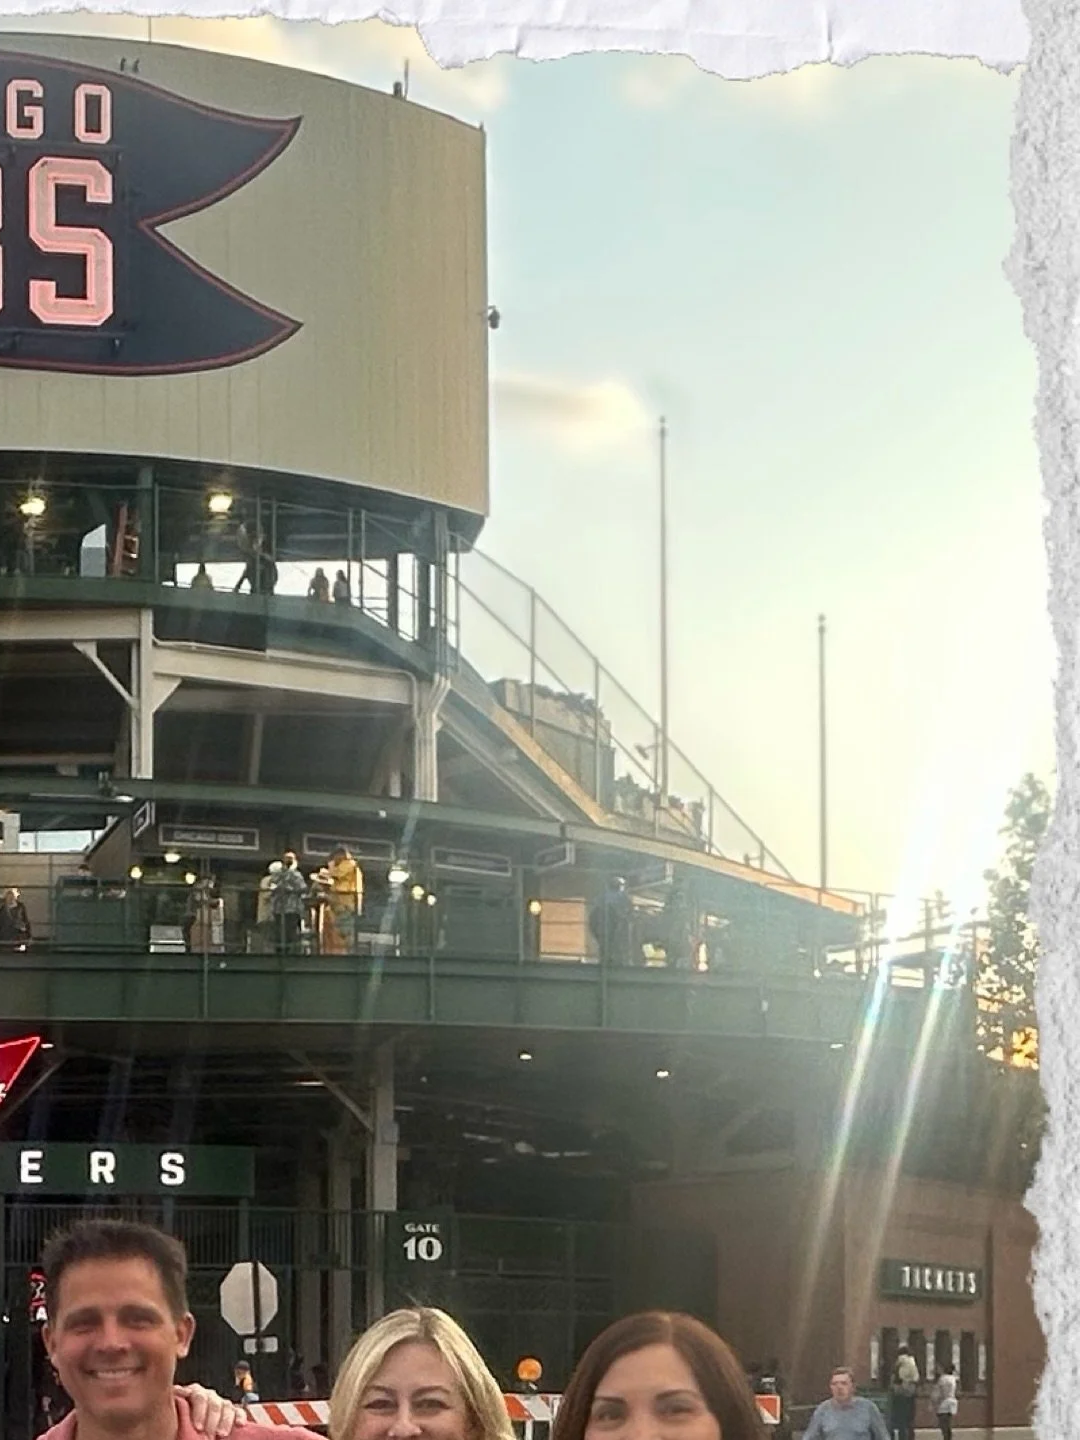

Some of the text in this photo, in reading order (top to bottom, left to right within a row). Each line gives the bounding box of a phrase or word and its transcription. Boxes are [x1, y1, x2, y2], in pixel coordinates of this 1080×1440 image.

[404, 1222, 441, 1233] GATE
[402, 1236, 443, 1261] 10
[901, 1265, 976, 1294] TICKETS
